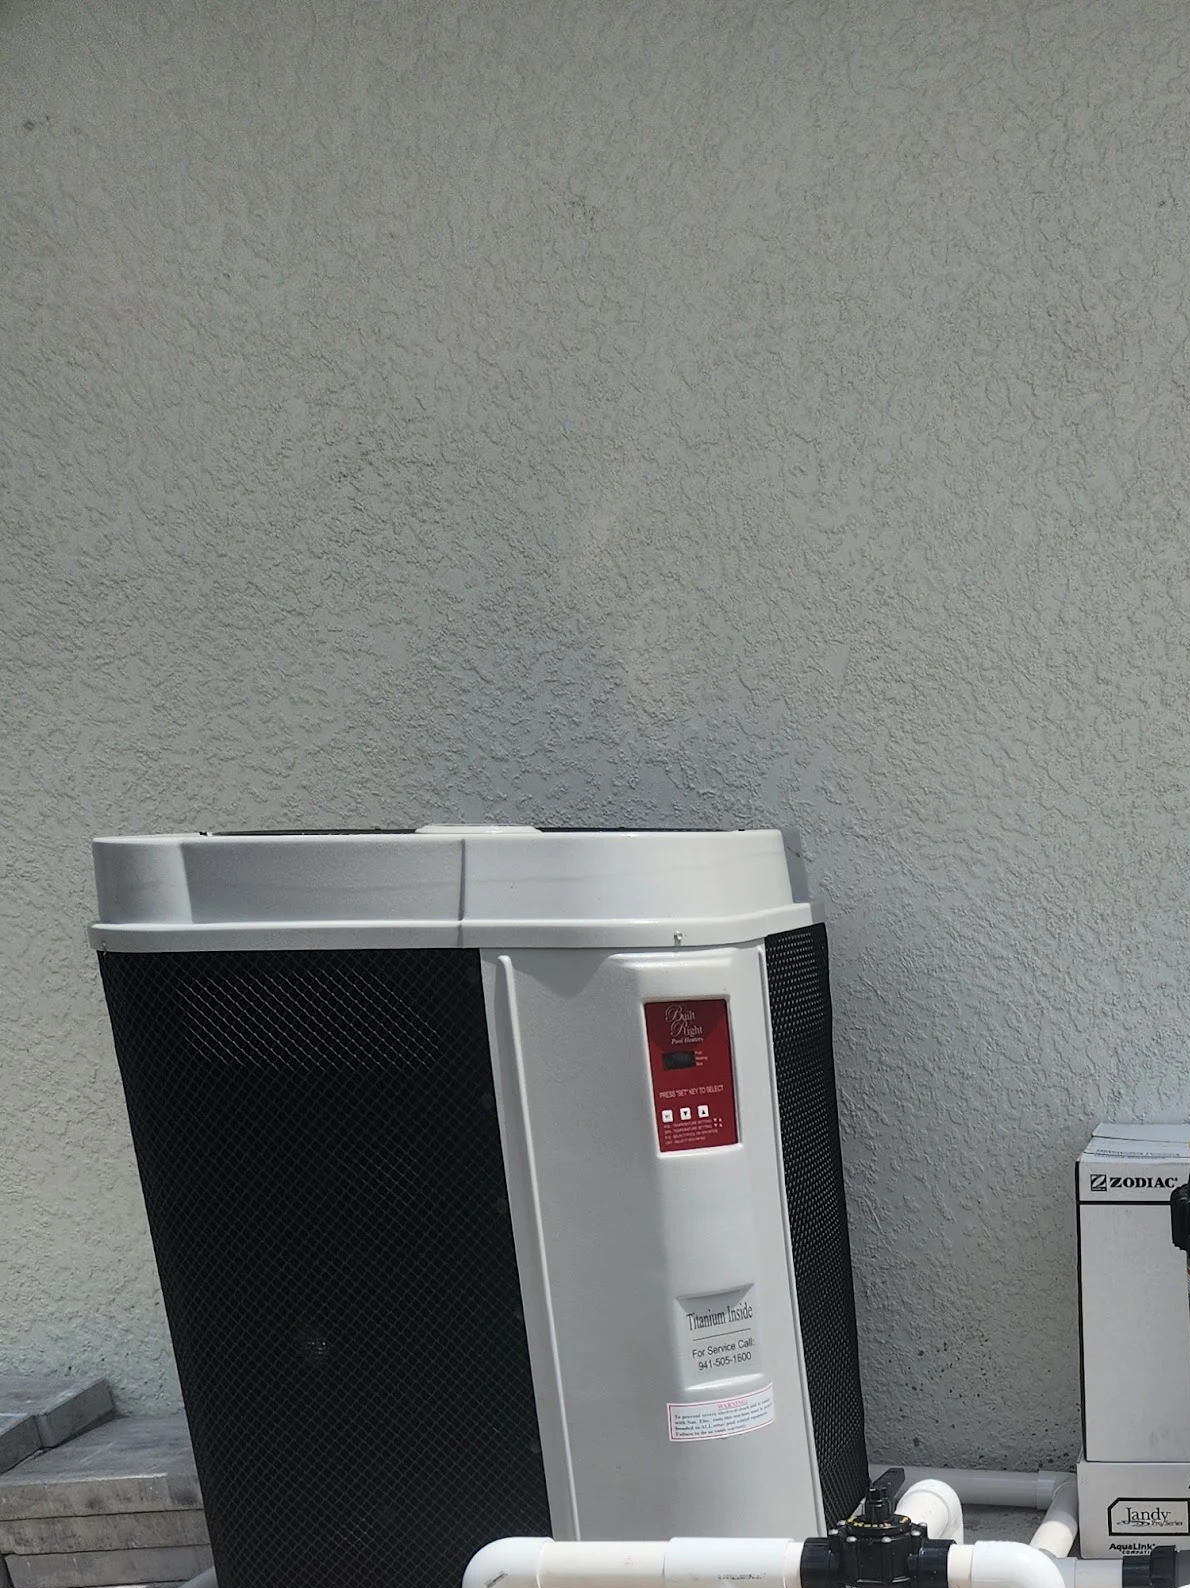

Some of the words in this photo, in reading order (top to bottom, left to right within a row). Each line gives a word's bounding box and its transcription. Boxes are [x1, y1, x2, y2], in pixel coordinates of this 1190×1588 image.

[665, 1003, 696, 1022] Built
[671, 1020, 703, 1037] Right
[659, 1090, 676, 1098] PRESS
[689, 1087, 699, 1095] KEY
[706, 1084, 724, 1093] SELECT
[1109, 1177, 1175, 1188] ZODIAC
[686, 1308, 726, 1331] Titanium
[726, 1303, 753, 1324] Inside
[692, 1348, 705, 1359] For
[707, 1342, 736, 1356] Service
[738, 1338, 756, 1350] Call:
[1125, 1507, 1168, 1524] Jandy
[1109, 1543, 1152, 1552] AquaLink
